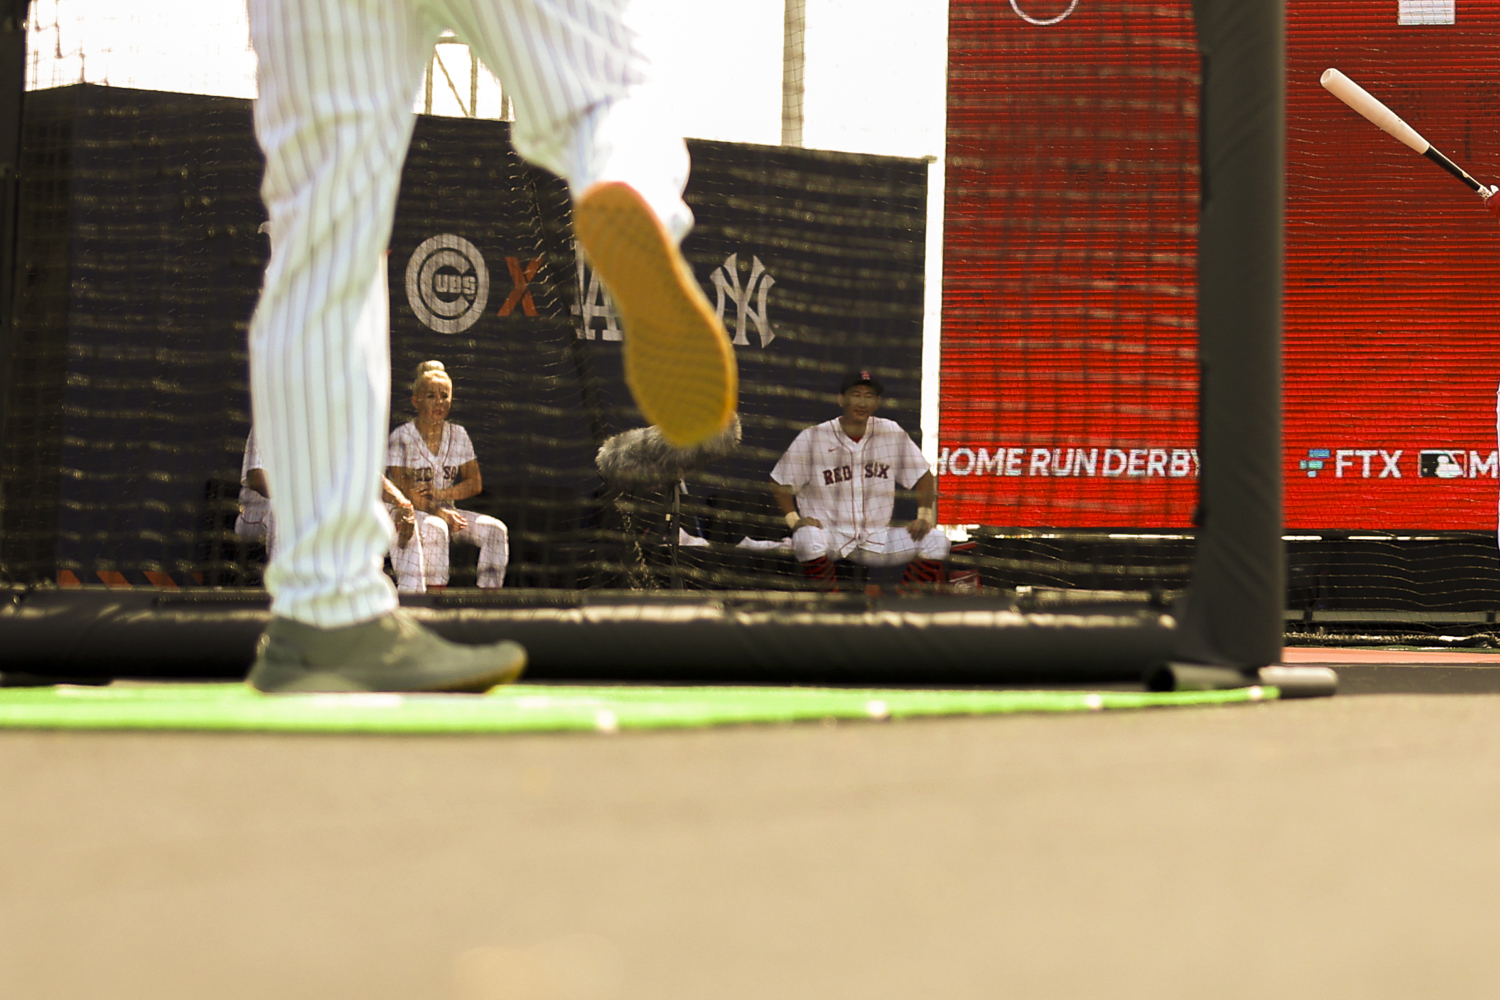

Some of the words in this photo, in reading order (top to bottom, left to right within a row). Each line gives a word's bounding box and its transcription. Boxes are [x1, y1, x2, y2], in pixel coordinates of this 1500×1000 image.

[497, 256, 544, 317] X
[709, 252, 776, 349] NY
[823, 466, 852, 485] RED
[1029, 448, 1099, 476] RUN
[1335, 449, 1404, 478] FTX
